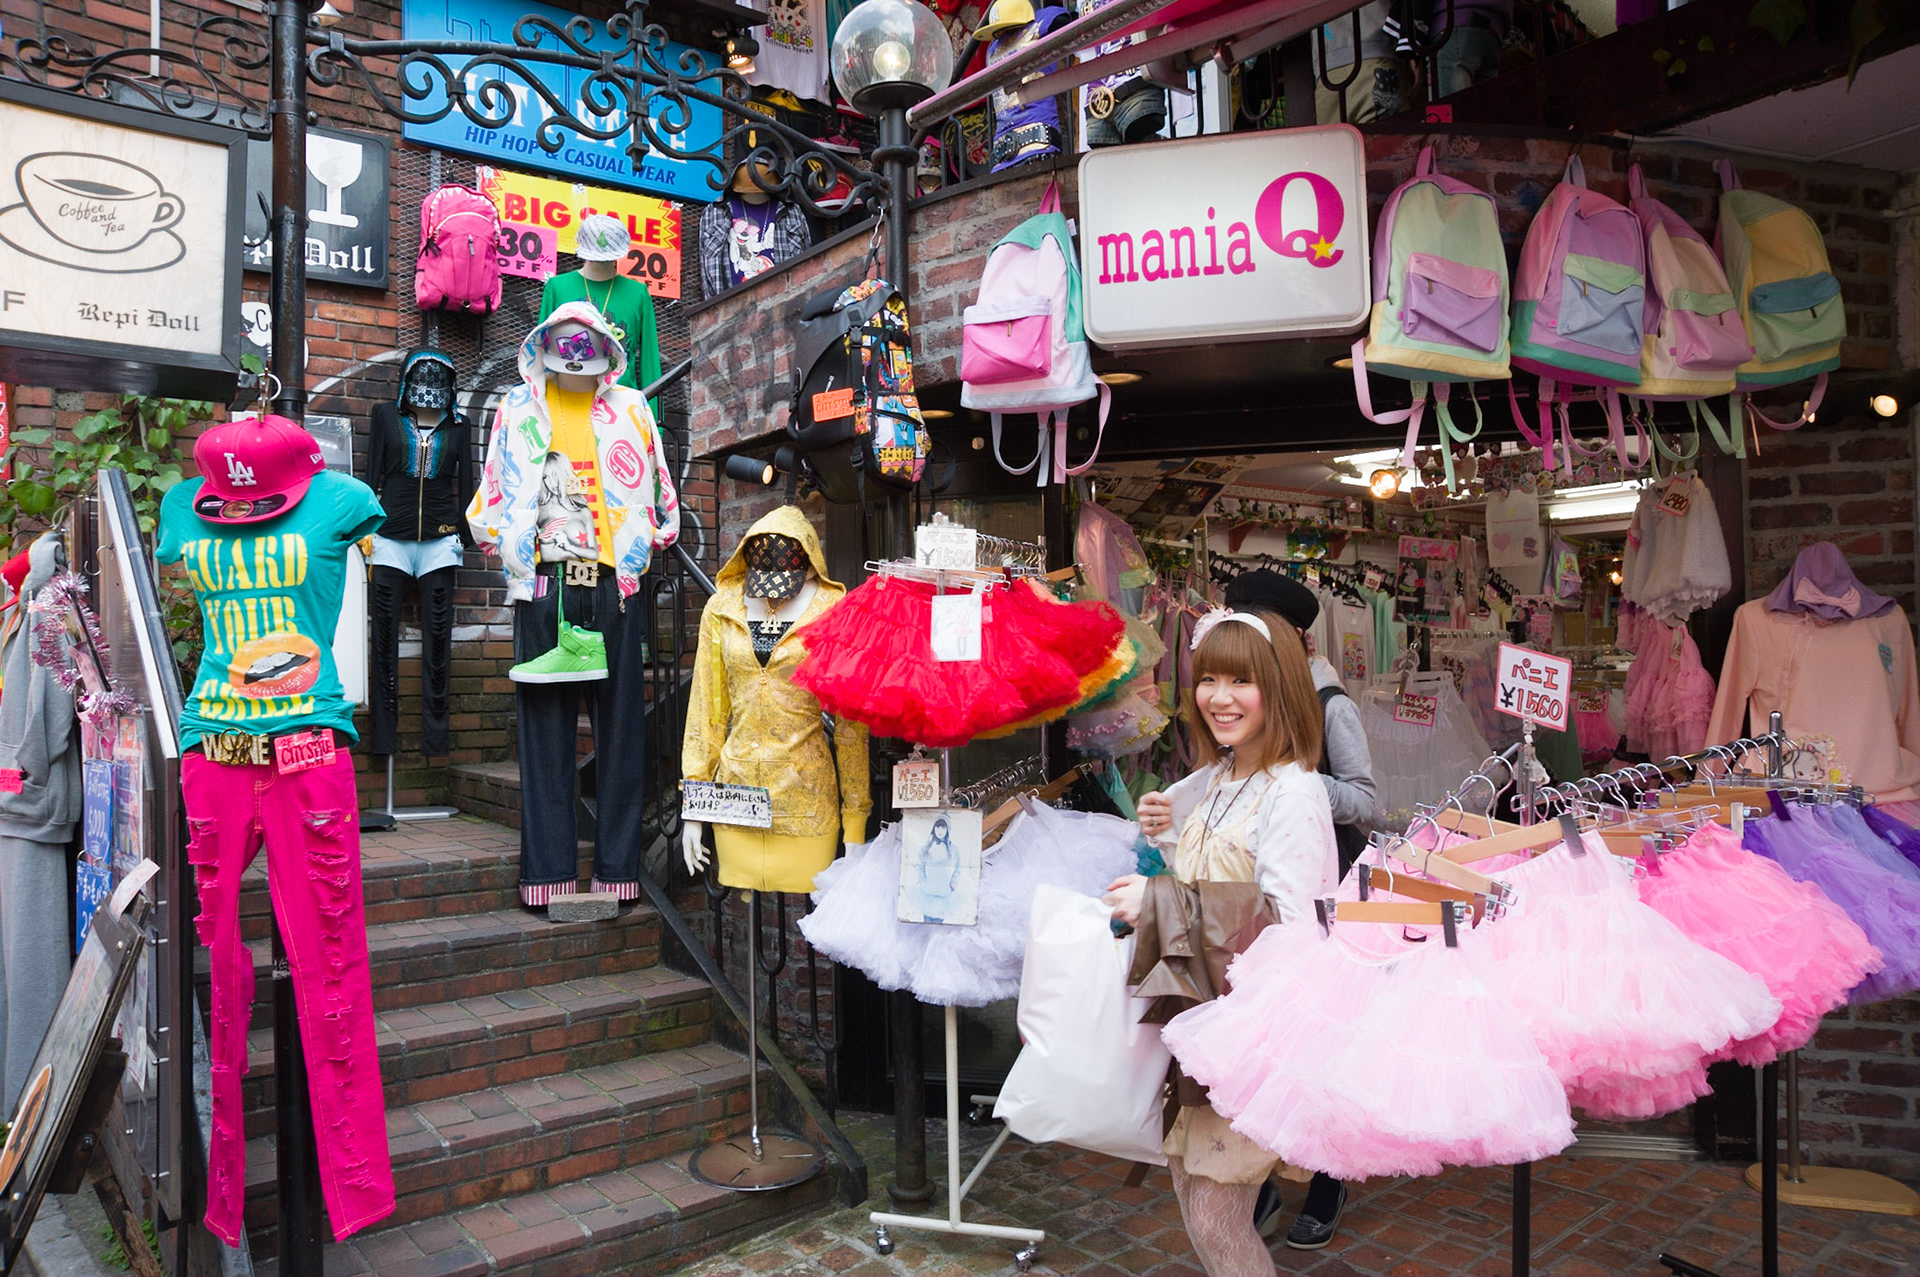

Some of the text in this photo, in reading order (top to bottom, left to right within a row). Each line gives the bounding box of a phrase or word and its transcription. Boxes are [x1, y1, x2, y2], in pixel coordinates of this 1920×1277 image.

[465, 125, 497, 146] HIP
[501, 133, 540, 155] HOP
[564, 148, 626, 175] CASUAL
[631, 164, 677, 185] WEAR
[59, 200, 104, 221] Coffee
[91, 207, 117, 223] and
[504, 192, 571, 229] BIG
[101, 222, 126, 236] Tea
[304, 237, 376, 273] Doll
[627, 249, 677, 282] 20%
[76, 302, 201, 332] Repi Doll
[223, 452, 257, 487] LA
[180, 533, 308, 592] GUARD
[918, 545, 975, 568] ¥1560
[1511, 657, 1559, 691] パニエ
[1500, 682, 1564, 722] ¥1560
[201, 732, 271, 766] WNE
[898, 767, 932, 783] パニエ
[897, 783, 934, 802] ¥1560
